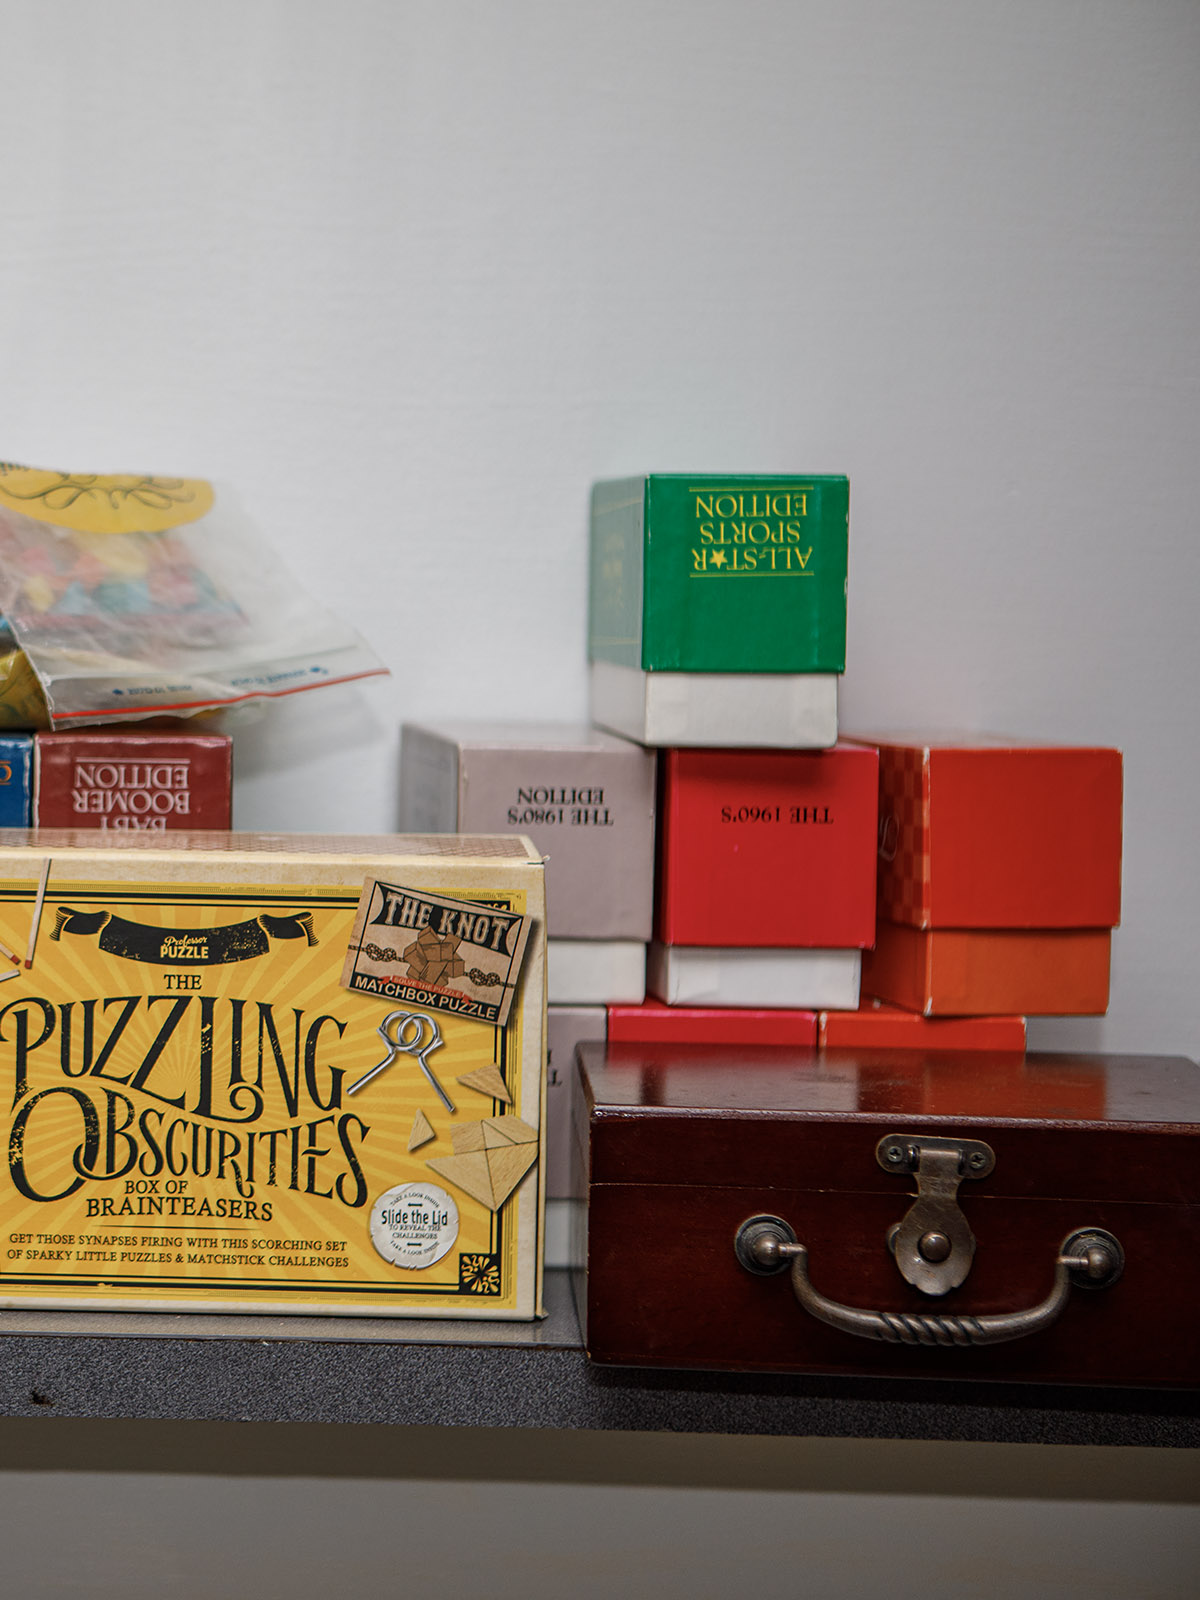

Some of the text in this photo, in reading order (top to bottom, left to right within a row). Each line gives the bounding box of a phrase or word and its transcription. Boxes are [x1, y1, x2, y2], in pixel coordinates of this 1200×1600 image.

[695, 493, 807, 518] EDITION
[699, 520, 801, 545] SPORTS
[73, 764, 189, 789] EDITION
[73, 790, 190, 814] BOOMER
[517, 786, 604, 805] EDITION
[506, 806, 613, 826] THE 1980'S
[721, 805, 833, 825] THE 1960'S
[384, 891, 510, 950] THE KNOT
[164, 934, 208, 947] Professor
[160, 945, 208, 958] PUZZLE
[164, 974, 202, 989] THE
[355, 975, 497, 1020] MATCHBOX PUZZLE
[8, 1086, 371, 1208] OBSCURITIES
[124, 1180, 189, 1196] BOX OF
[85, 1196, 273, 1222] BRAINTEASERS
[381, 1209, 448, 1225] Slide the Lid
[9, 1233, 348, 1252] GET THOSE SYNAPSES FIRING WITH THIS SCORCHING SET
[7, 1248, 349, 1268] OF SPARKY LITTLE PUZZLES & MATCHSTICK CHALLENGES
